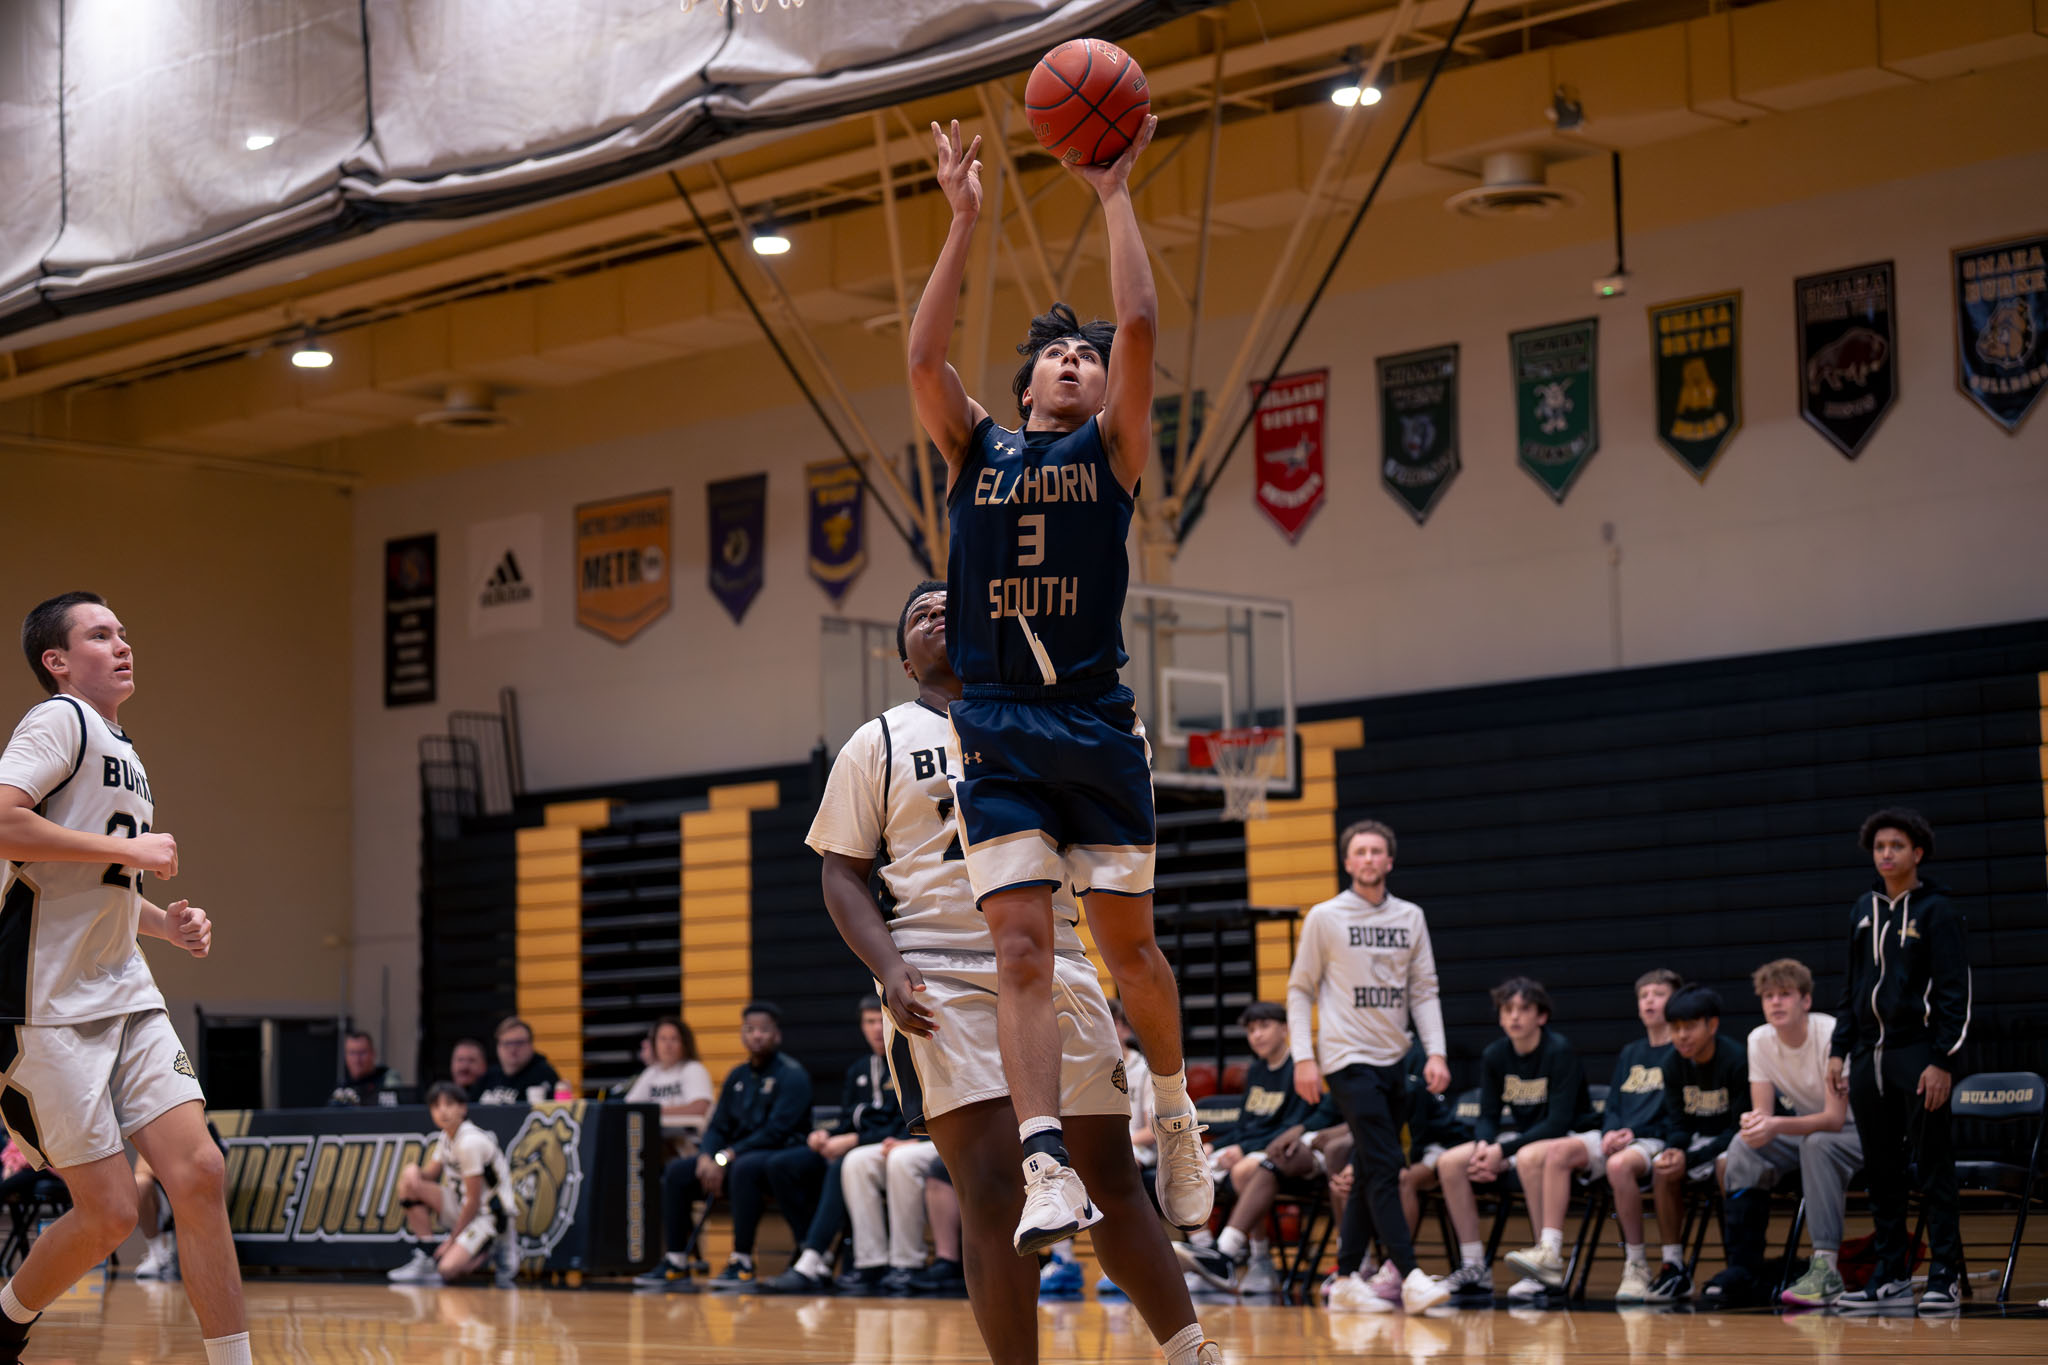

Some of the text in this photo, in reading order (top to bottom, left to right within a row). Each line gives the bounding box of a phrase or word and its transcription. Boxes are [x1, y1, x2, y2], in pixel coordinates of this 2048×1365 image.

[975, 463, 1098, 505] ELKHORN
[1018, 514, 1045, 566] 3
[988, 577, 1078, 619] SOUTH
[102, 755, 154, 807] BURK
[1349, 926, 1410, 948] BURKE
[1960, 1088, 2034, 1104] BULLDOGS
